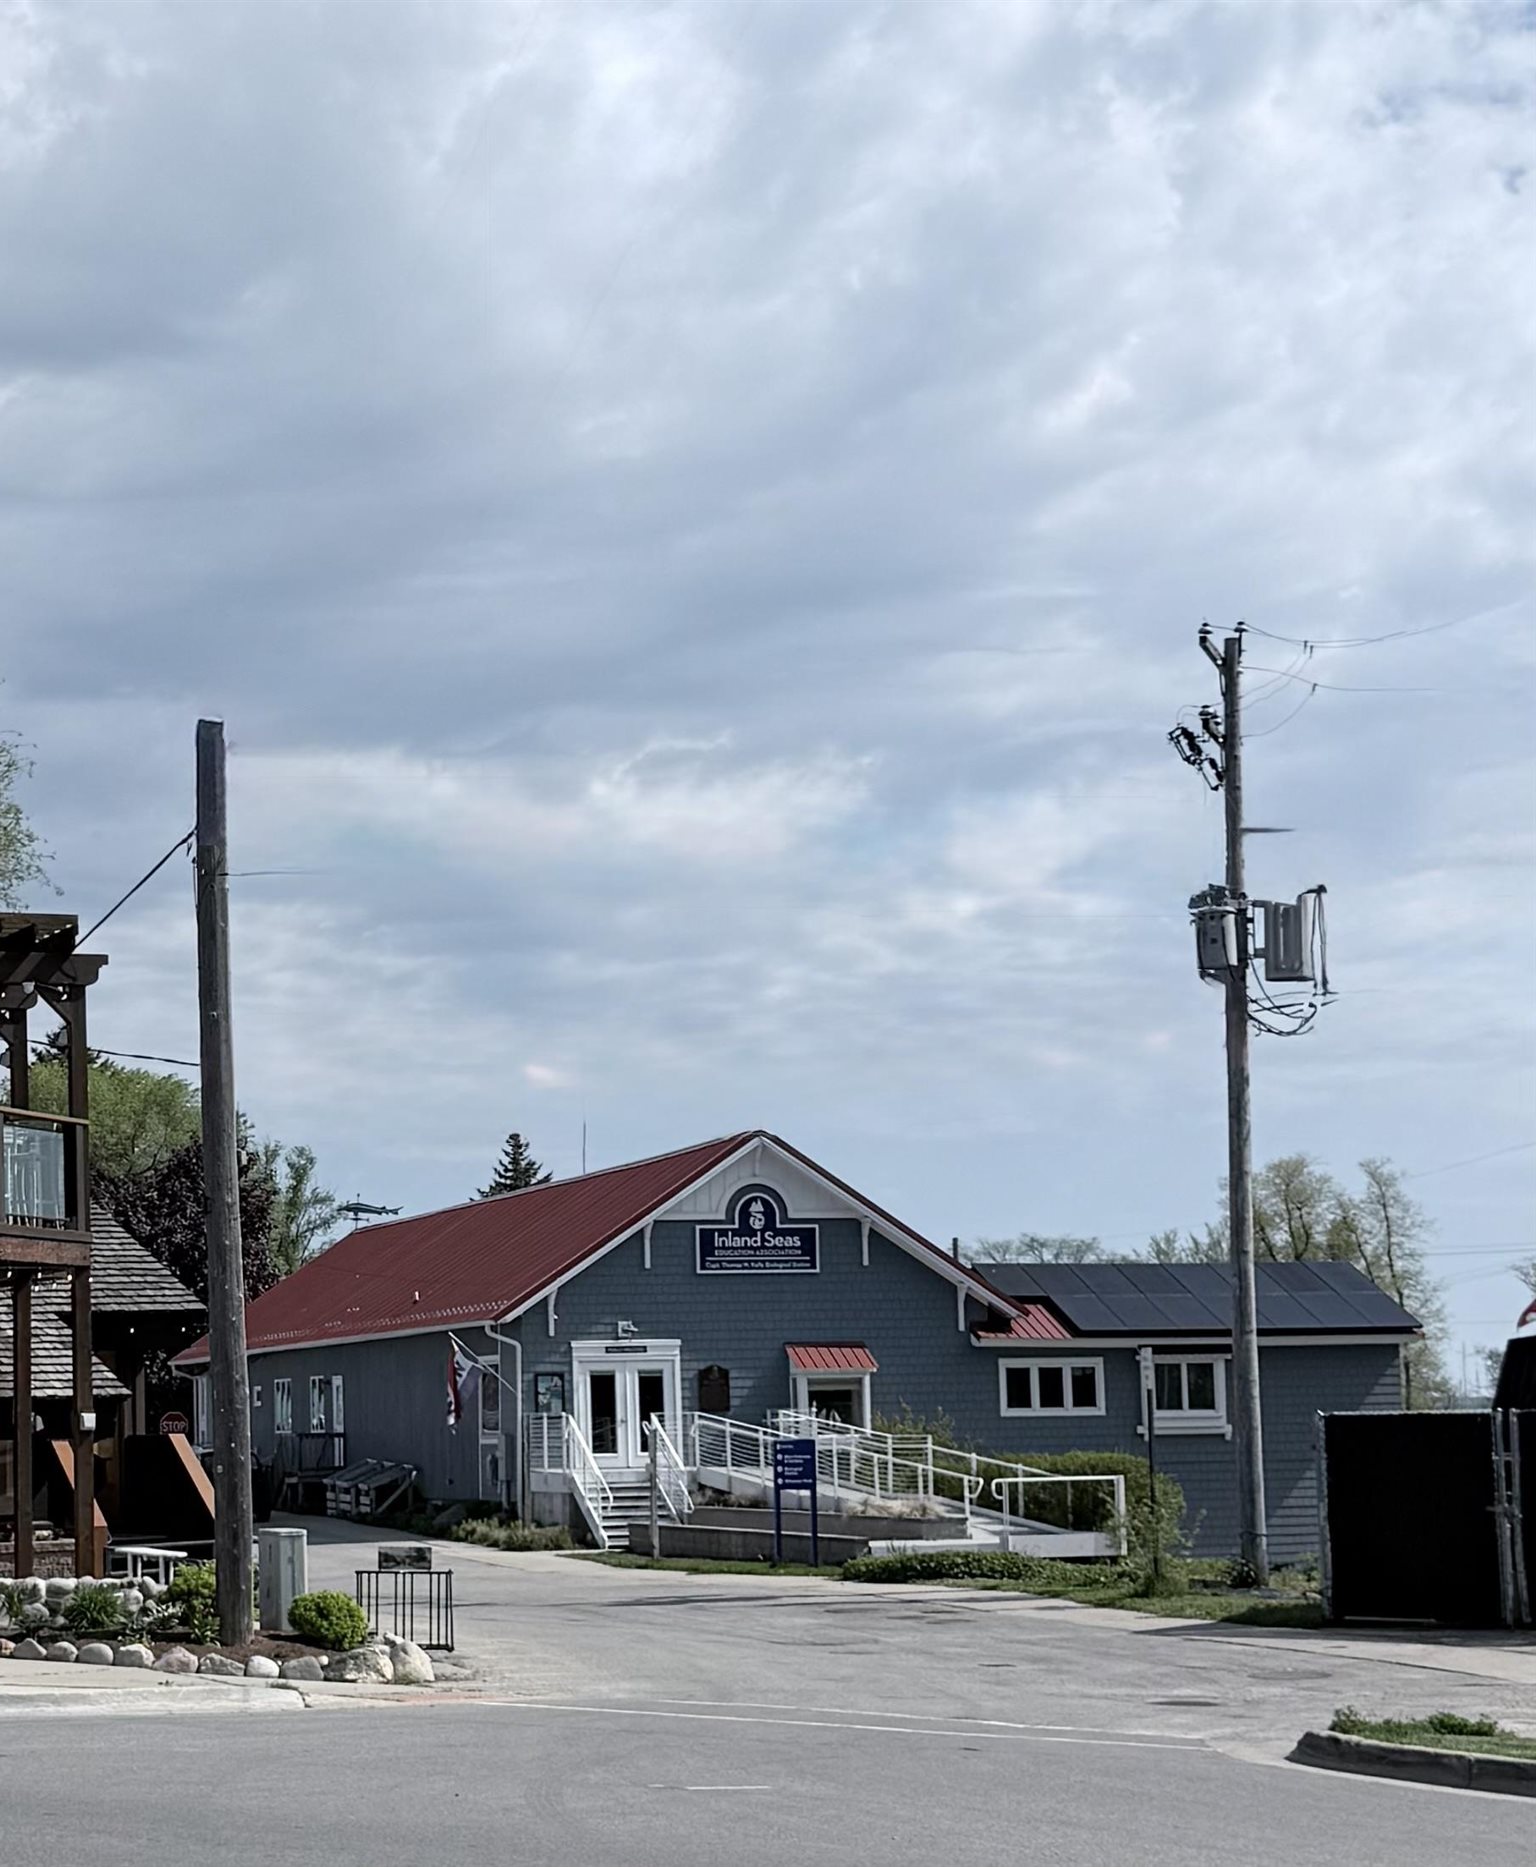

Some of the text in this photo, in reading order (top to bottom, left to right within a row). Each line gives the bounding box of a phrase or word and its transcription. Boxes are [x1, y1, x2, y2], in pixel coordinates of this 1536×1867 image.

[714, 1230, 801, 1248] Inland Seas
[162, 1420, 186, 1432] STOP
